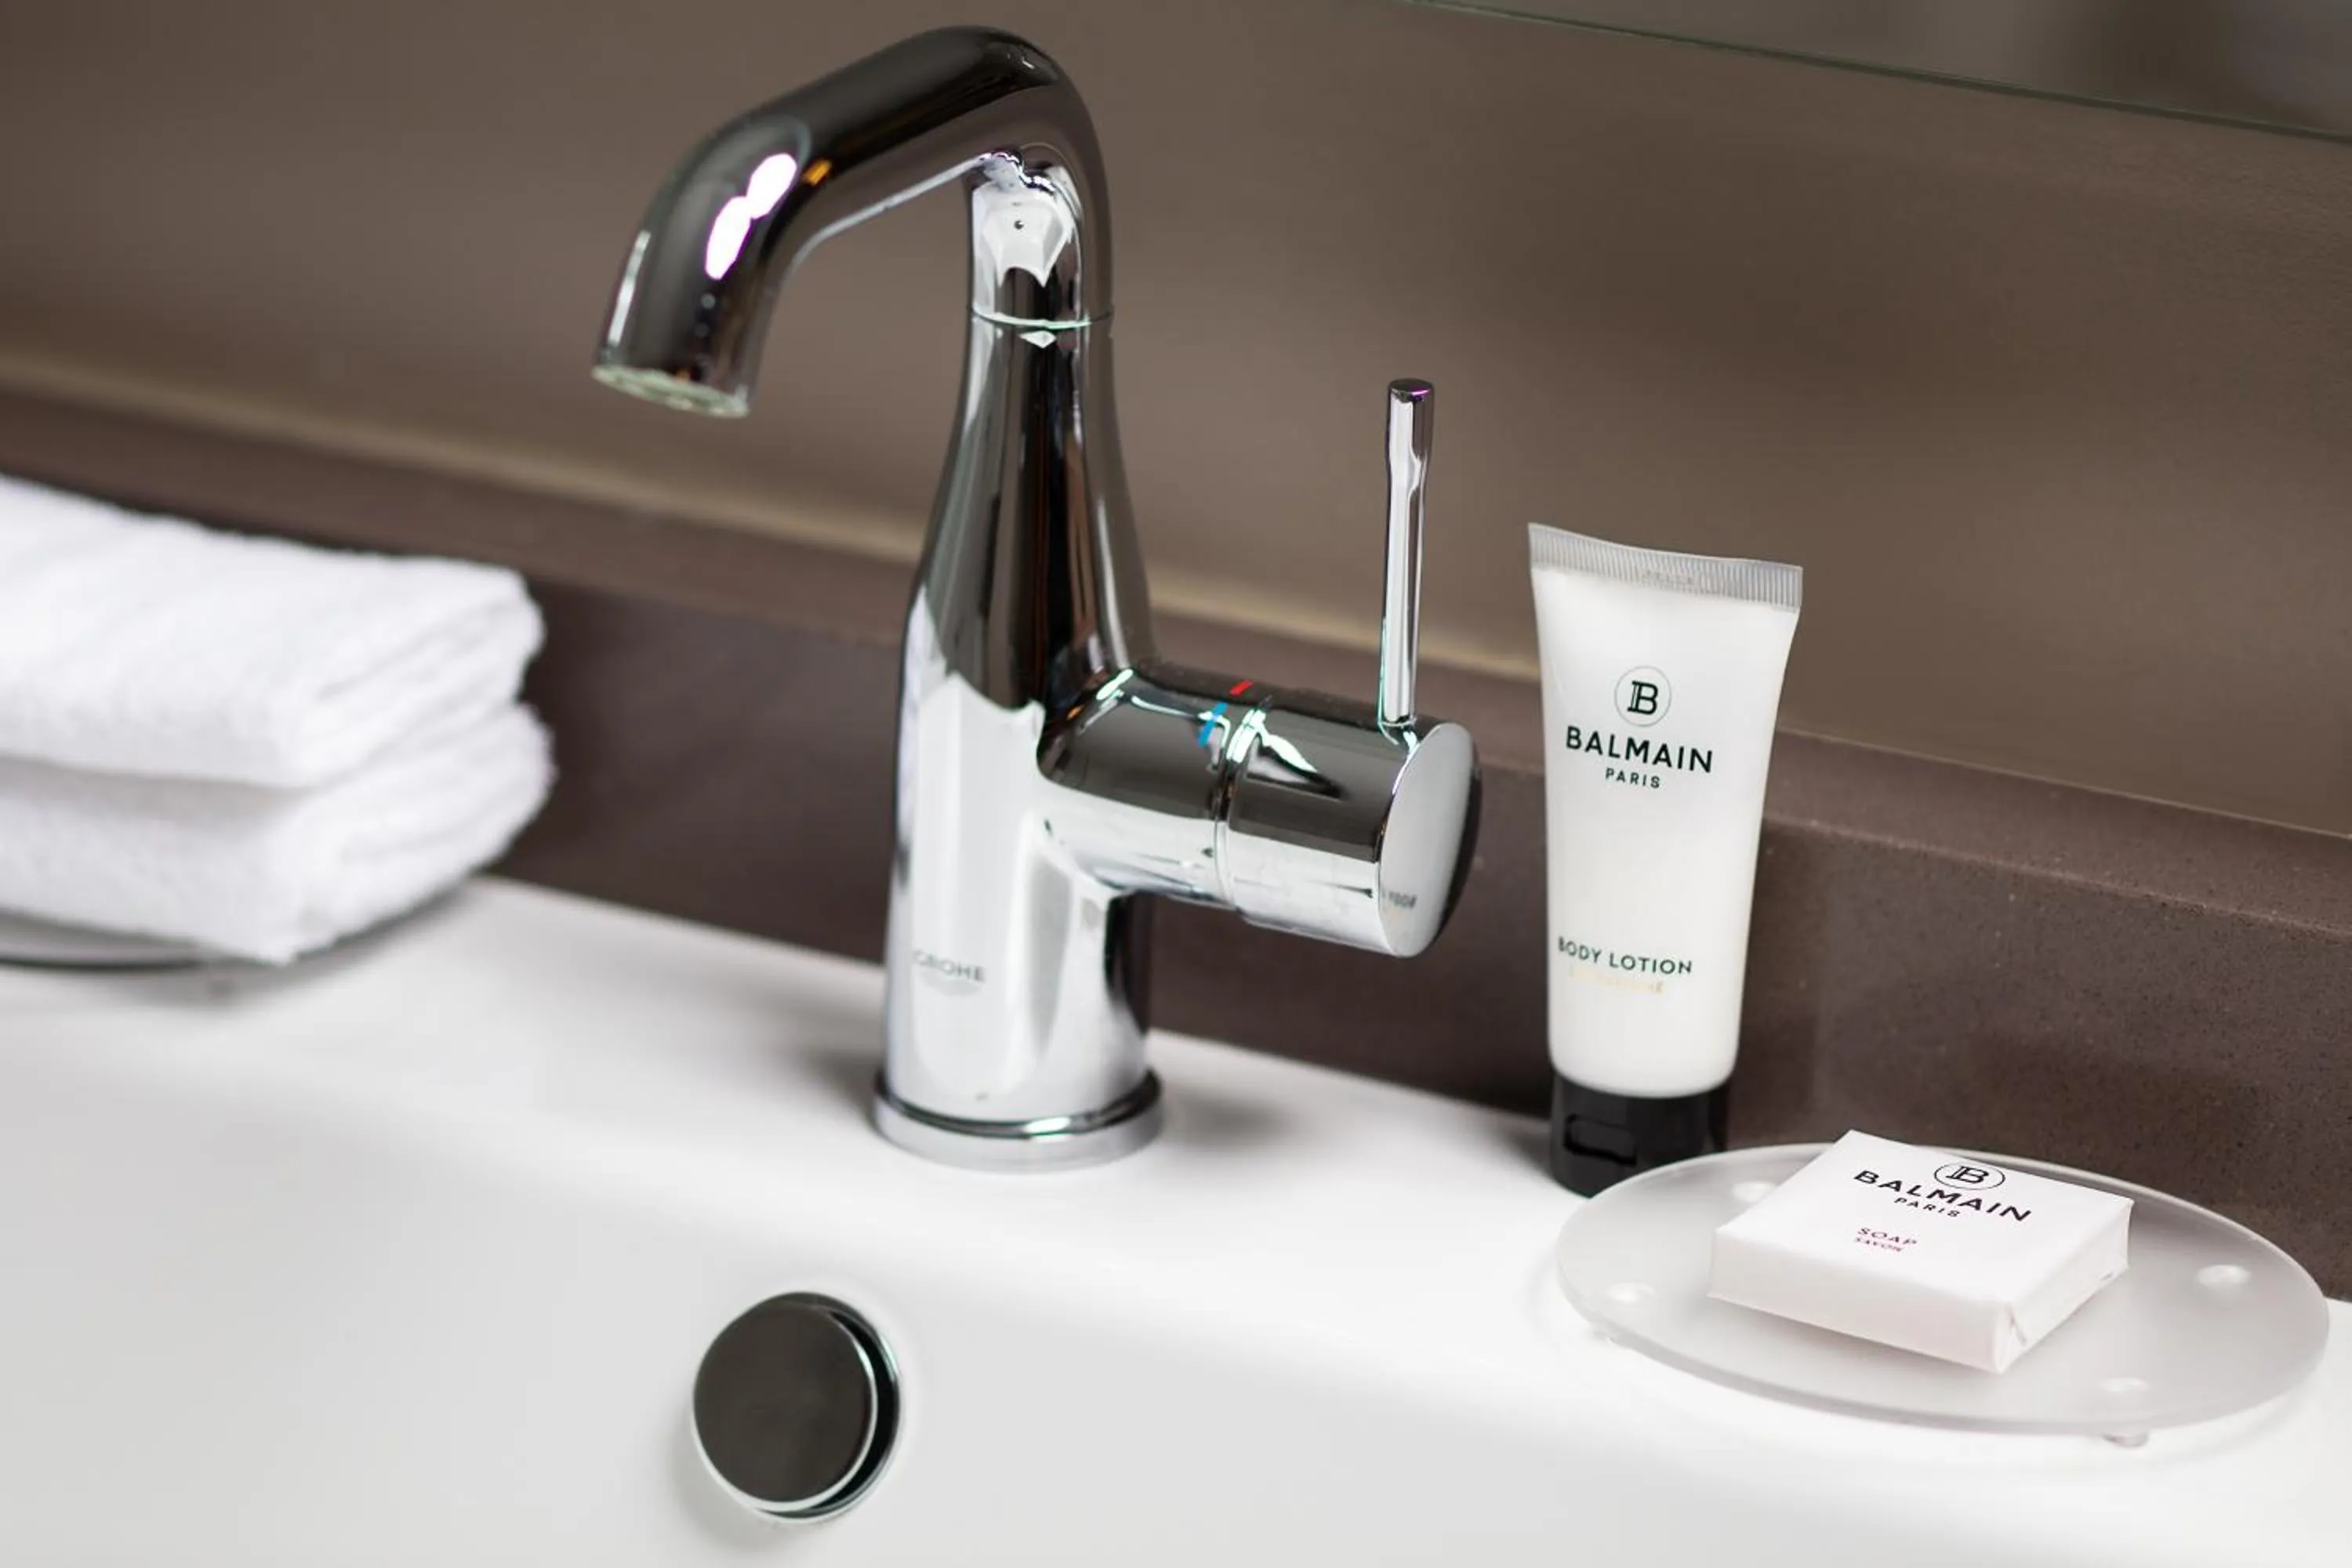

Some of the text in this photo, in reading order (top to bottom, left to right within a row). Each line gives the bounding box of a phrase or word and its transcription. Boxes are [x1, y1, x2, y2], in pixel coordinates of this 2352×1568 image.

[1566, 726, 1713, 772] BALMAIN
[1606, 768, 1661, 788] PARIS
[1559, 936, 1692, 975] BODY LOTION
[1854, 1171, 2031, 1221] BALMAIN
[1894, 1198, 1961, 1218] PARIS
[1857, 1228, 1918, 1244] SOAP
